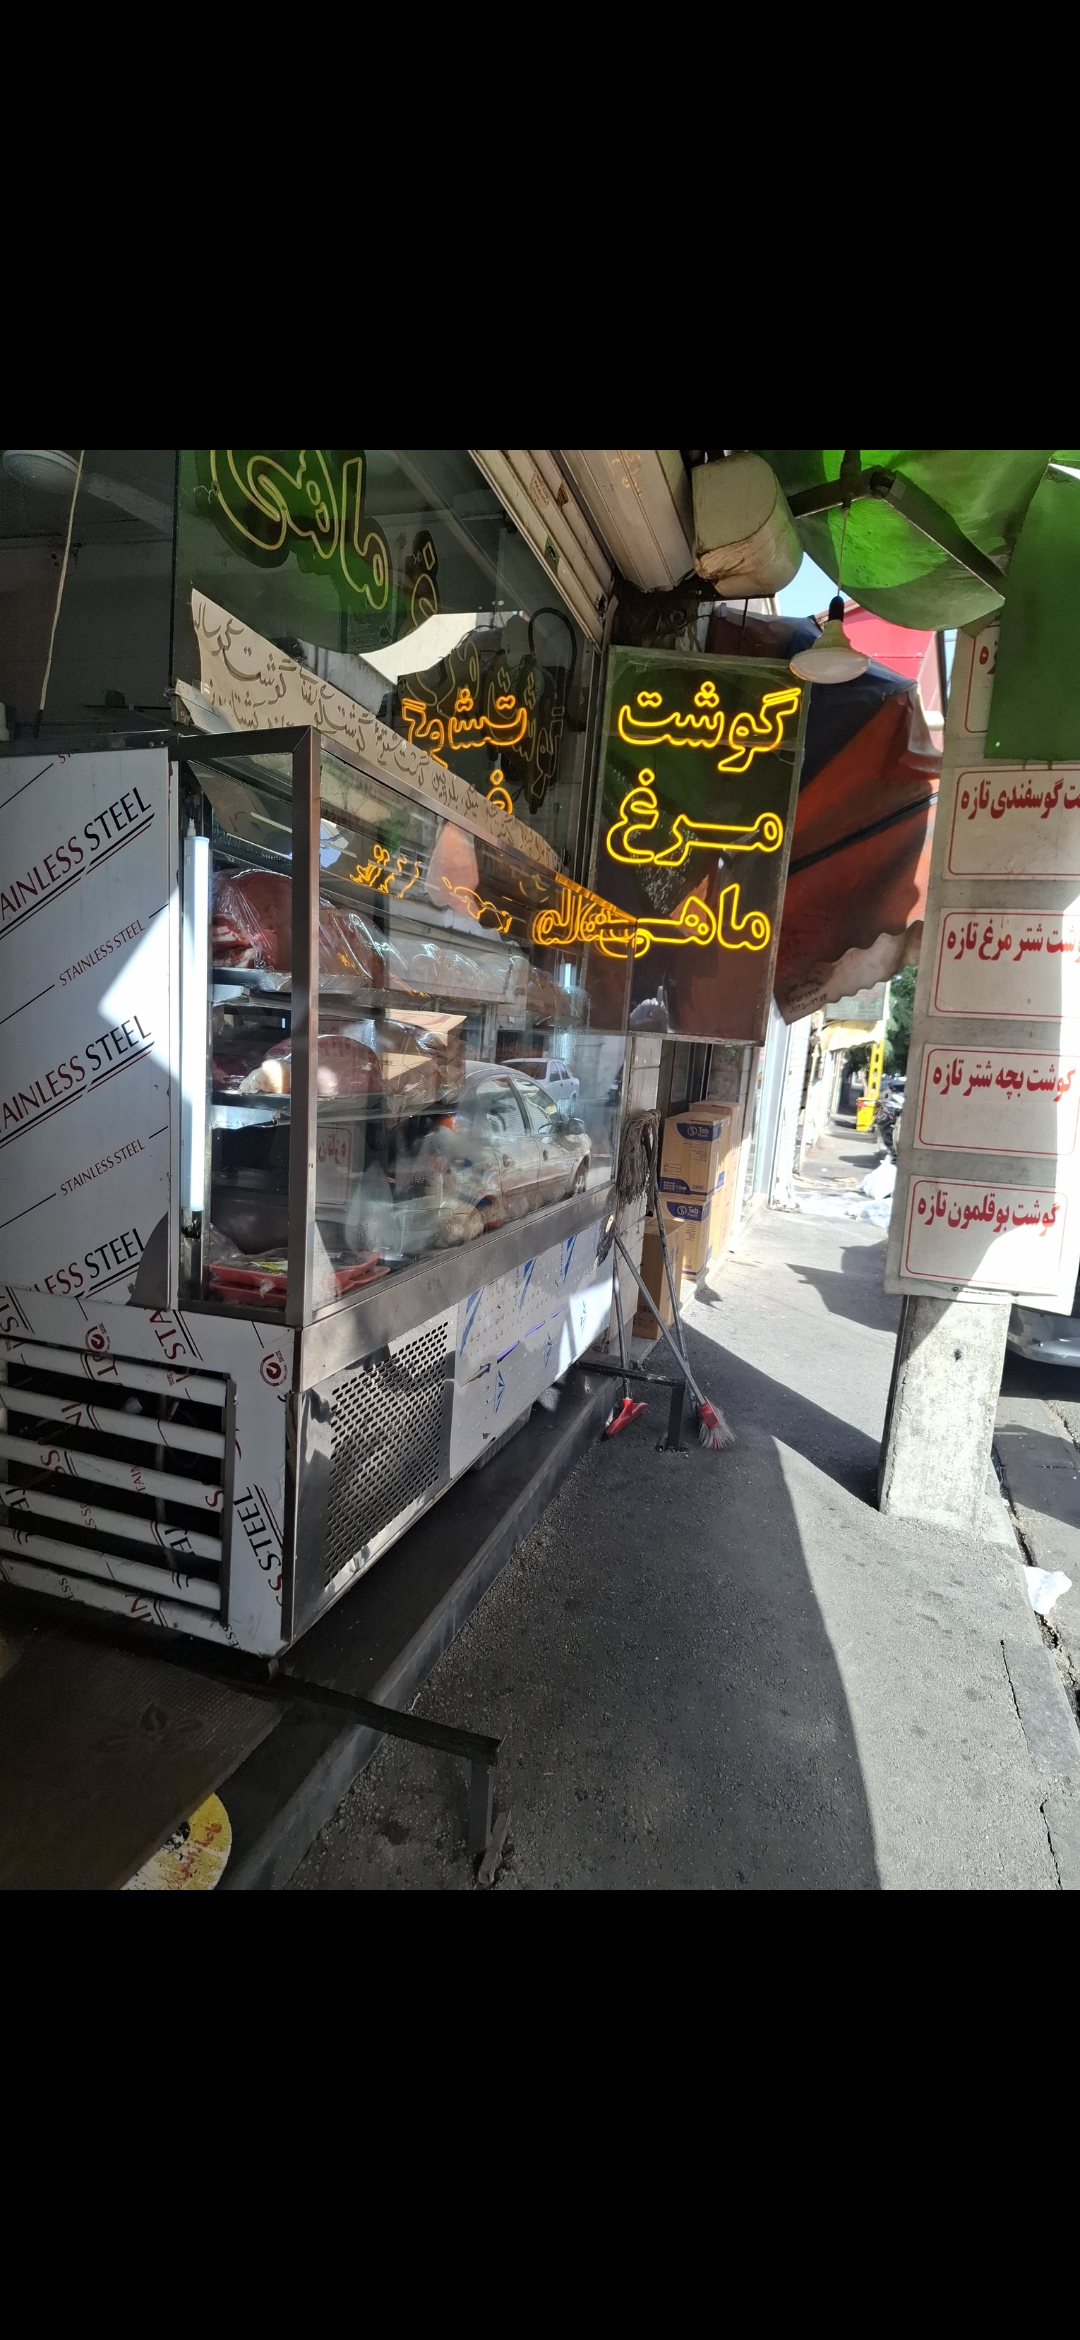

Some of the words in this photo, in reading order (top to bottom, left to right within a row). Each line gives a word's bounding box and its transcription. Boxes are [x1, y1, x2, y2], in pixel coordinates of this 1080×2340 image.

[619, 681, 802, 773] گوشت
[606, 768, 784, 867] مرغ
[961, 779, 990, 820] تازه
[990, 778, 1064, 819] گوسفندی
[0, 836, 84, 921] AINLESS
[84, 787, 152, 852] STEEL
[600, 883, 771, 959] ماهی
[946, 920, 979, 961] تازه
[978, 918, 1012, 961] مرغ
[59, 939, 115, 987] STAINLESS
[113, 919, 146, 950] STEEL
[1013, 923, 1044, 962] شتر
[85, 1015, 152, 1071] STEEL
[933, 1057, 964, 1095] تازه
[962, 1060, 992, 1097] شتر
[995, 1067, 1024, 1101] بچه
[1026, 1064, 1076, 1103] گوشت
[60, 1154, 116, 1197] STAINLESS
[113, 1138, 146, 1165] STEEL
[917, 1190, 948, 1226] تازه
[1012, 1200, 1060, 1237] گوشت
[233, 1486, 282, 1572] STEEL
